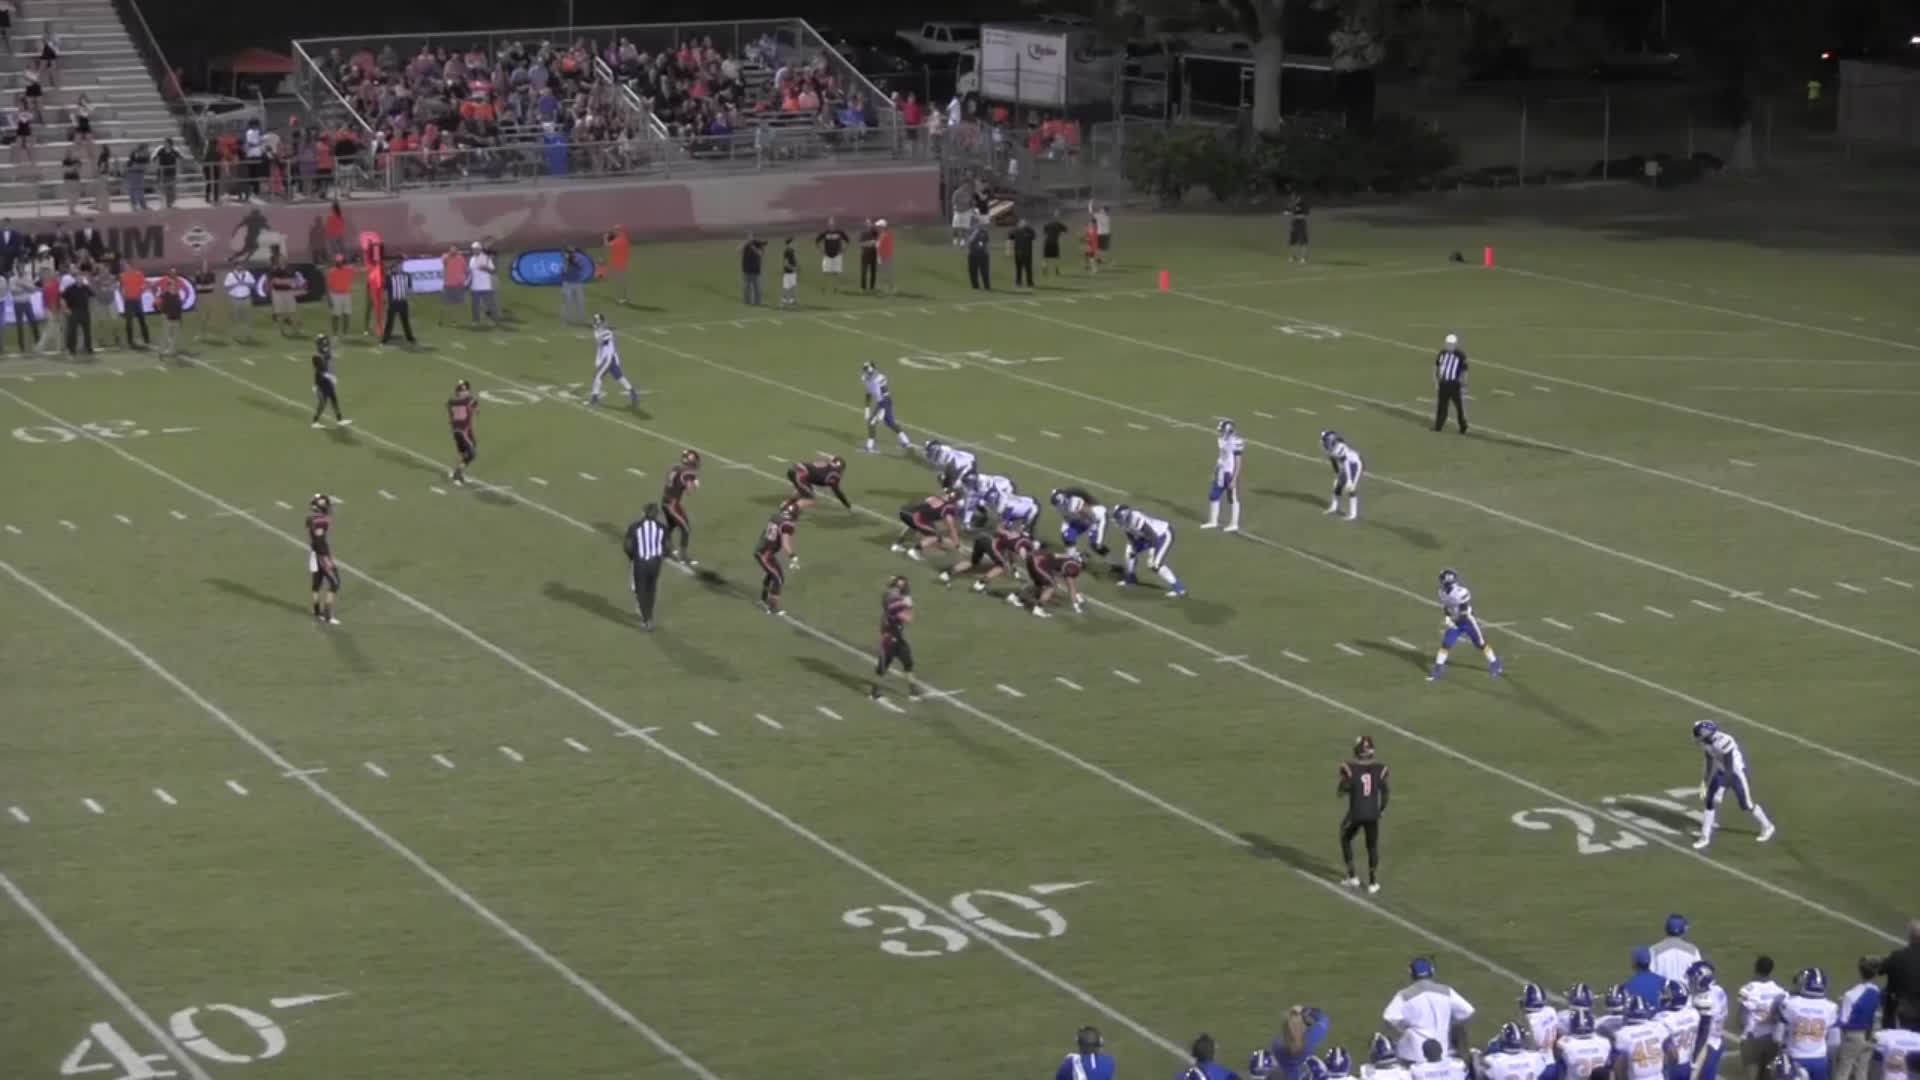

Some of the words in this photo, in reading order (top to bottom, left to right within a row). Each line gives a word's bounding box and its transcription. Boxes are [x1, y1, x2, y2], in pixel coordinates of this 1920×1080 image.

[1360, 772, 1372, 797] 1
[842, 889, 1068, 957] 30
[60, 1003, 287, 1080] 40
